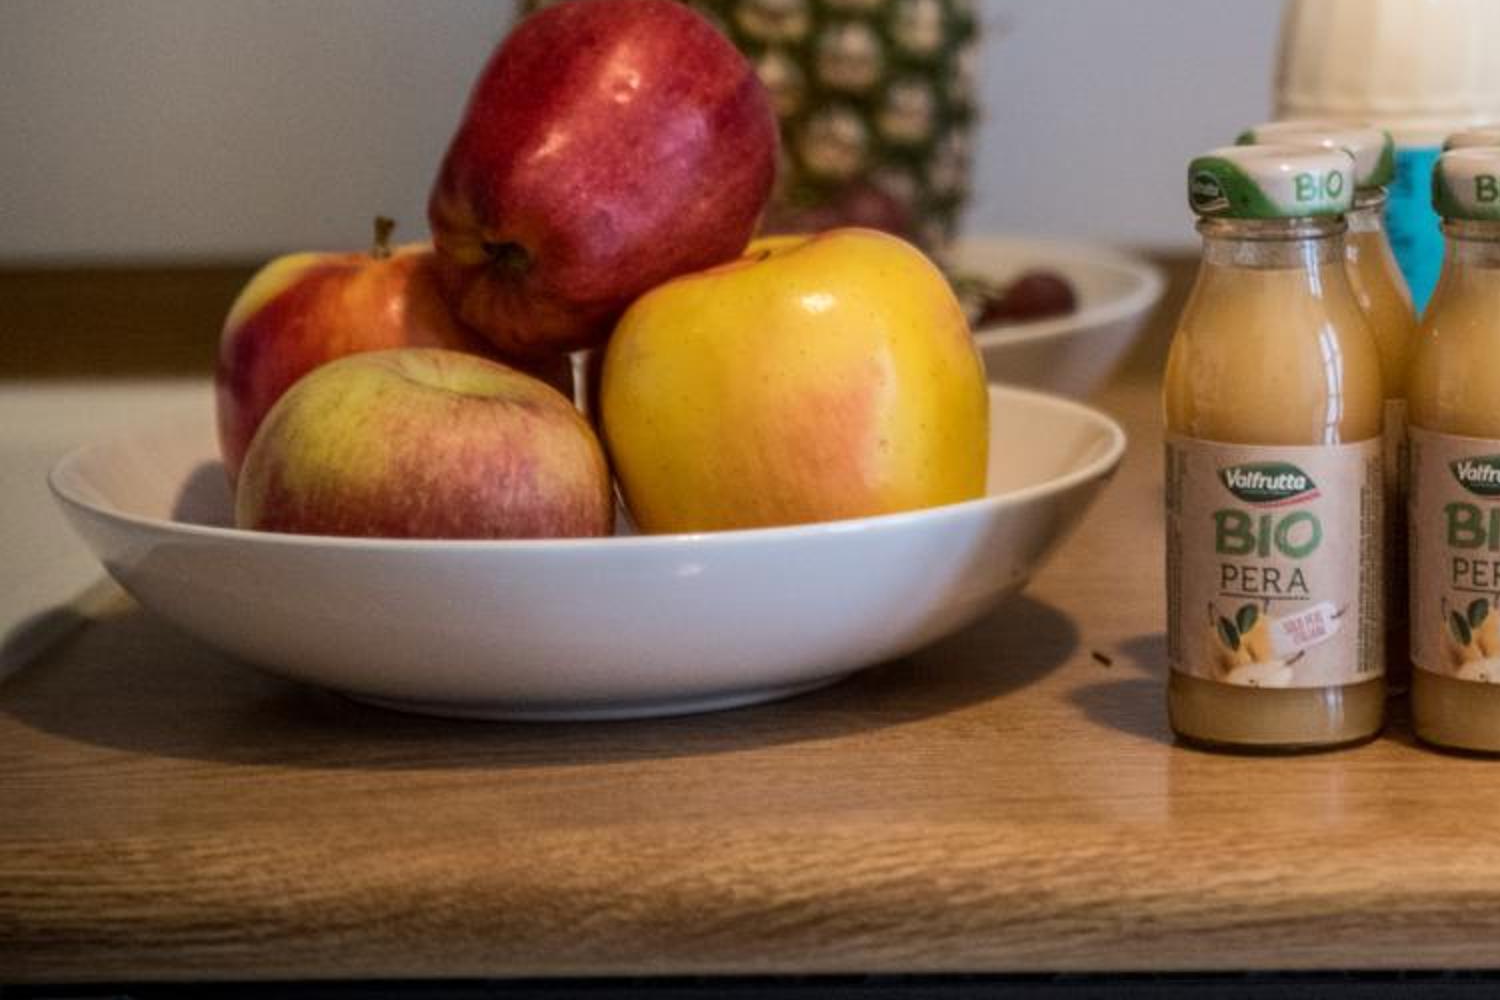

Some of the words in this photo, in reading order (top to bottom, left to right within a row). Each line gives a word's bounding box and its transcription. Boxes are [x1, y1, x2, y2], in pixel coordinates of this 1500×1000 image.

[1294, 169, 1344, 202] BIO
[1225, 468, 1307, 491] Valfrutta
[1215, 508, 1323, 559] BIO
[1220, 564, 1310, 594] PERA
